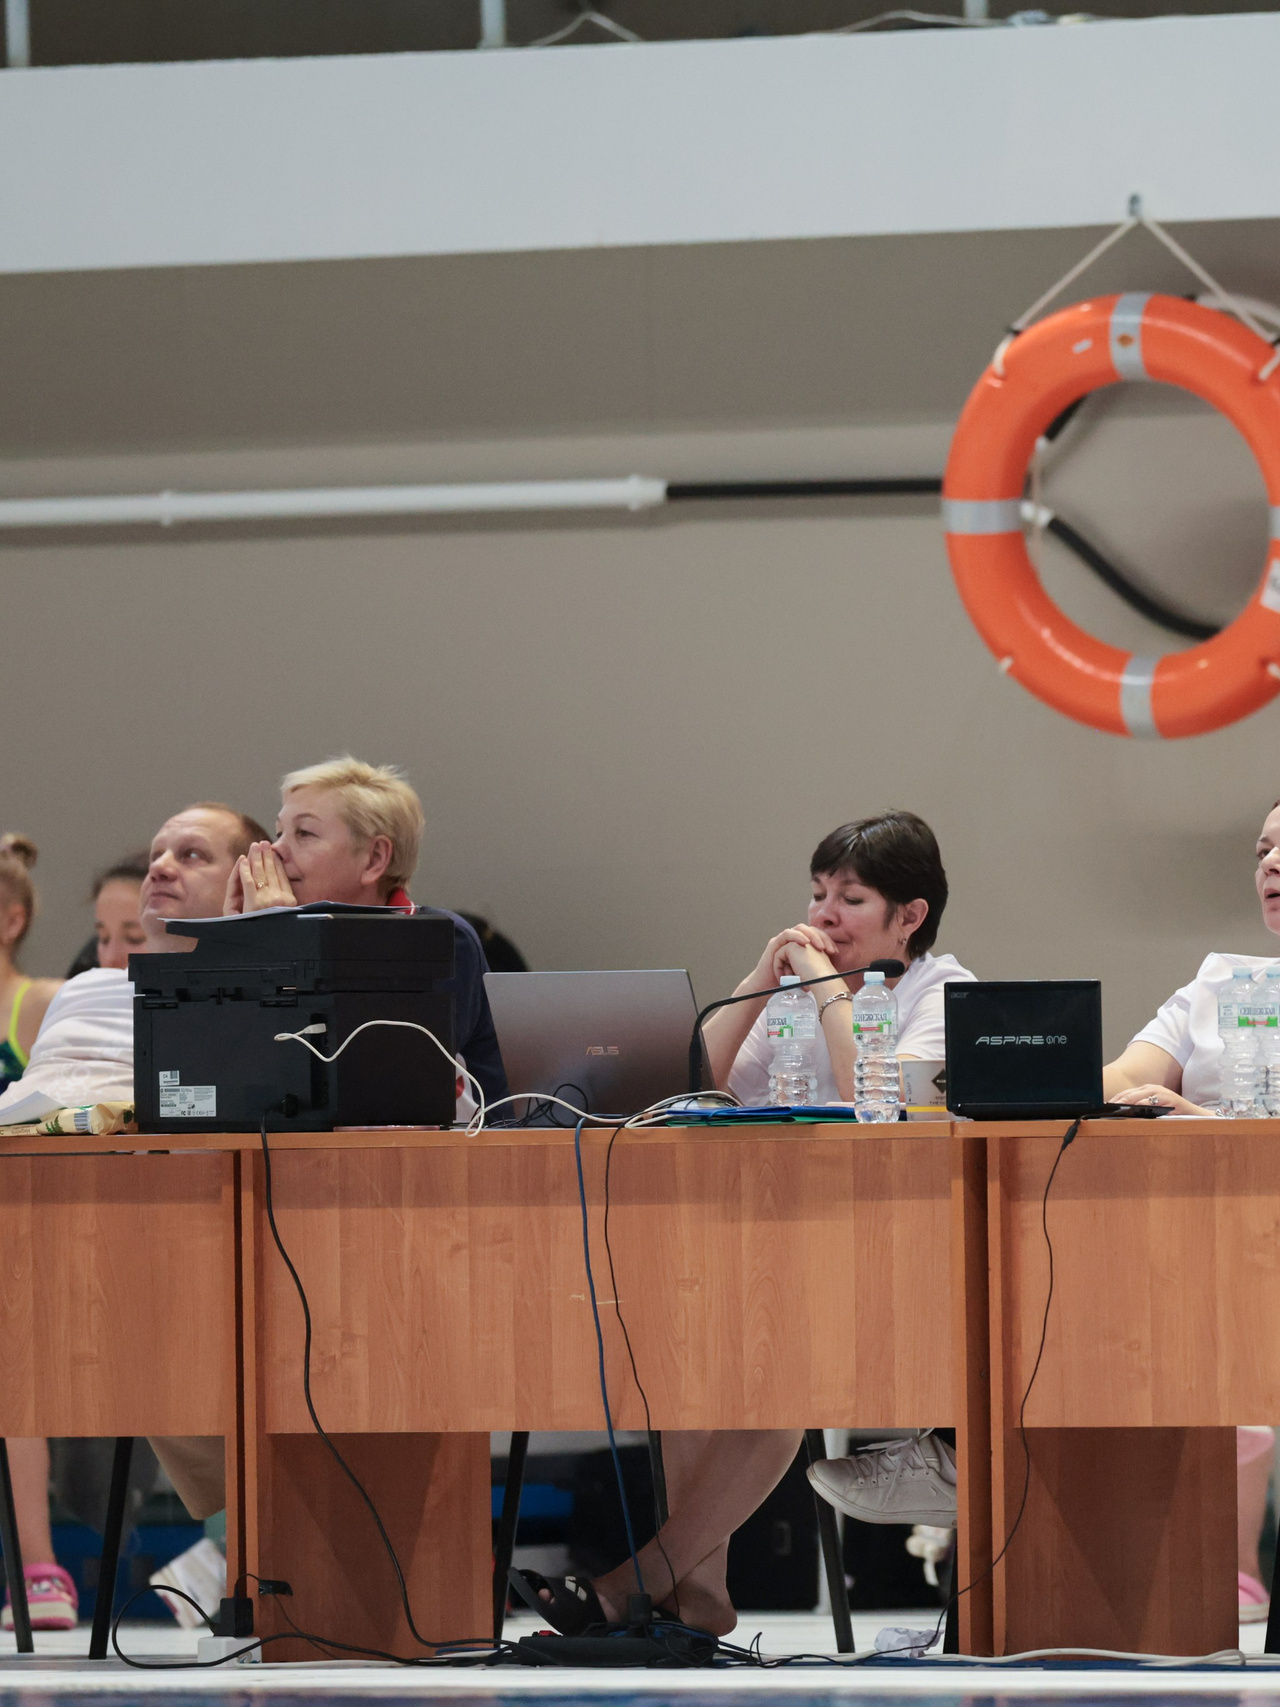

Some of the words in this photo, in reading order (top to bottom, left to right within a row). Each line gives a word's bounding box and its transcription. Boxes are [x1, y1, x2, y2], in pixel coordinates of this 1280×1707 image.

[975, 1035, 1044, 1046] ASPIRE
[1046, 1035, 1068, 1045] one
[585, 1046, 619, 1056] ASUS
